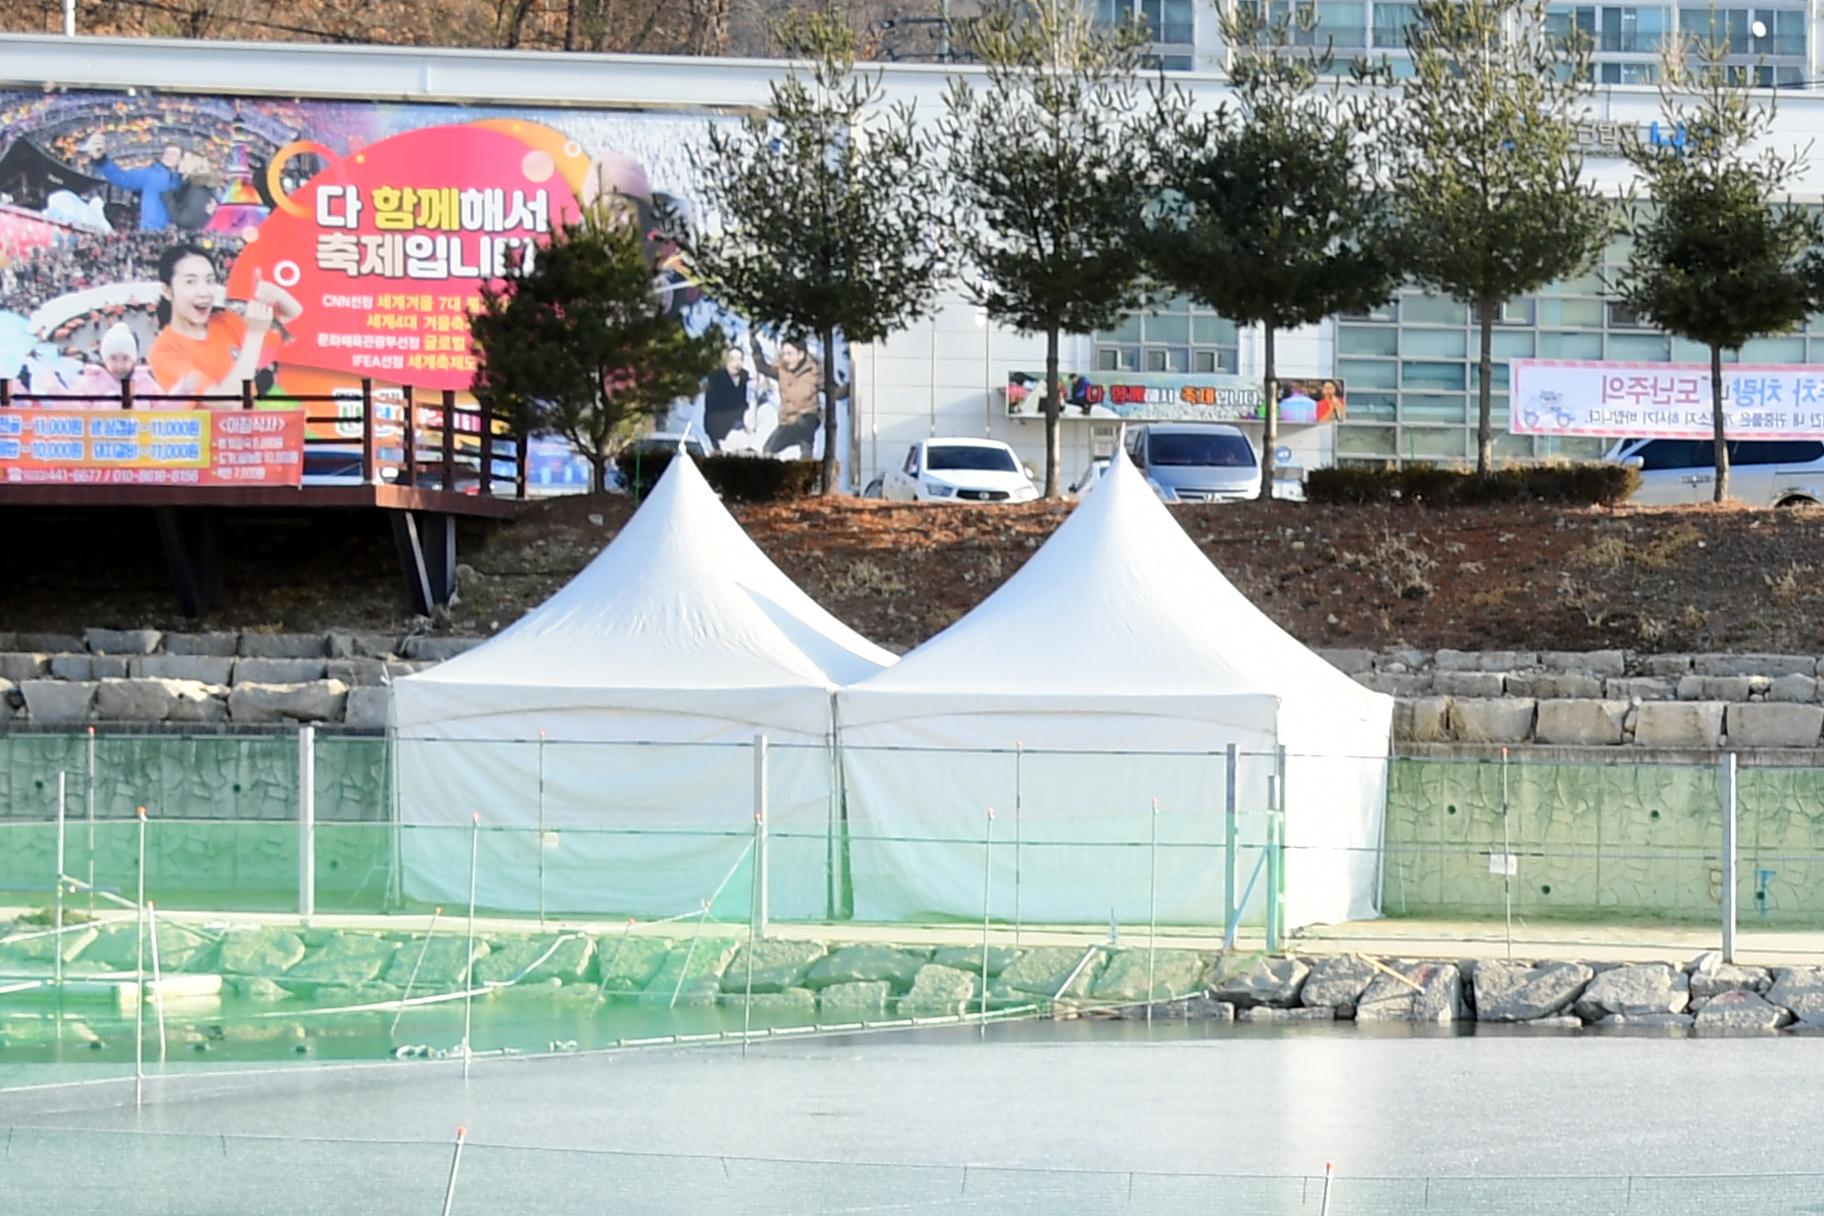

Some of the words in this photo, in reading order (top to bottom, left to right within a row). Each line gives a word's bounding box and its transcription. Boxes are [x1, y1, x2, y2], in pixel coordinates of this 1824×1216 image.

[316, 185, 362, 229] 다
[371, 185, 548, 232] 함께해서
[322, 294, 374, 309] CNN선정
[377, 294, 433, 313] 세계겨울
[438, 297, 461, 312] 7대
[366, 313, 418, 331] 세계4대
[423, 315, 472, 332] 겨울축
[317, 332, 420, 350] 문화체육관광부선정
[423, 333, 466, 351] 글로벌
[352, 354, 404, 370] IFEA선정
[407, 354, 477, 372] 세계축제도
